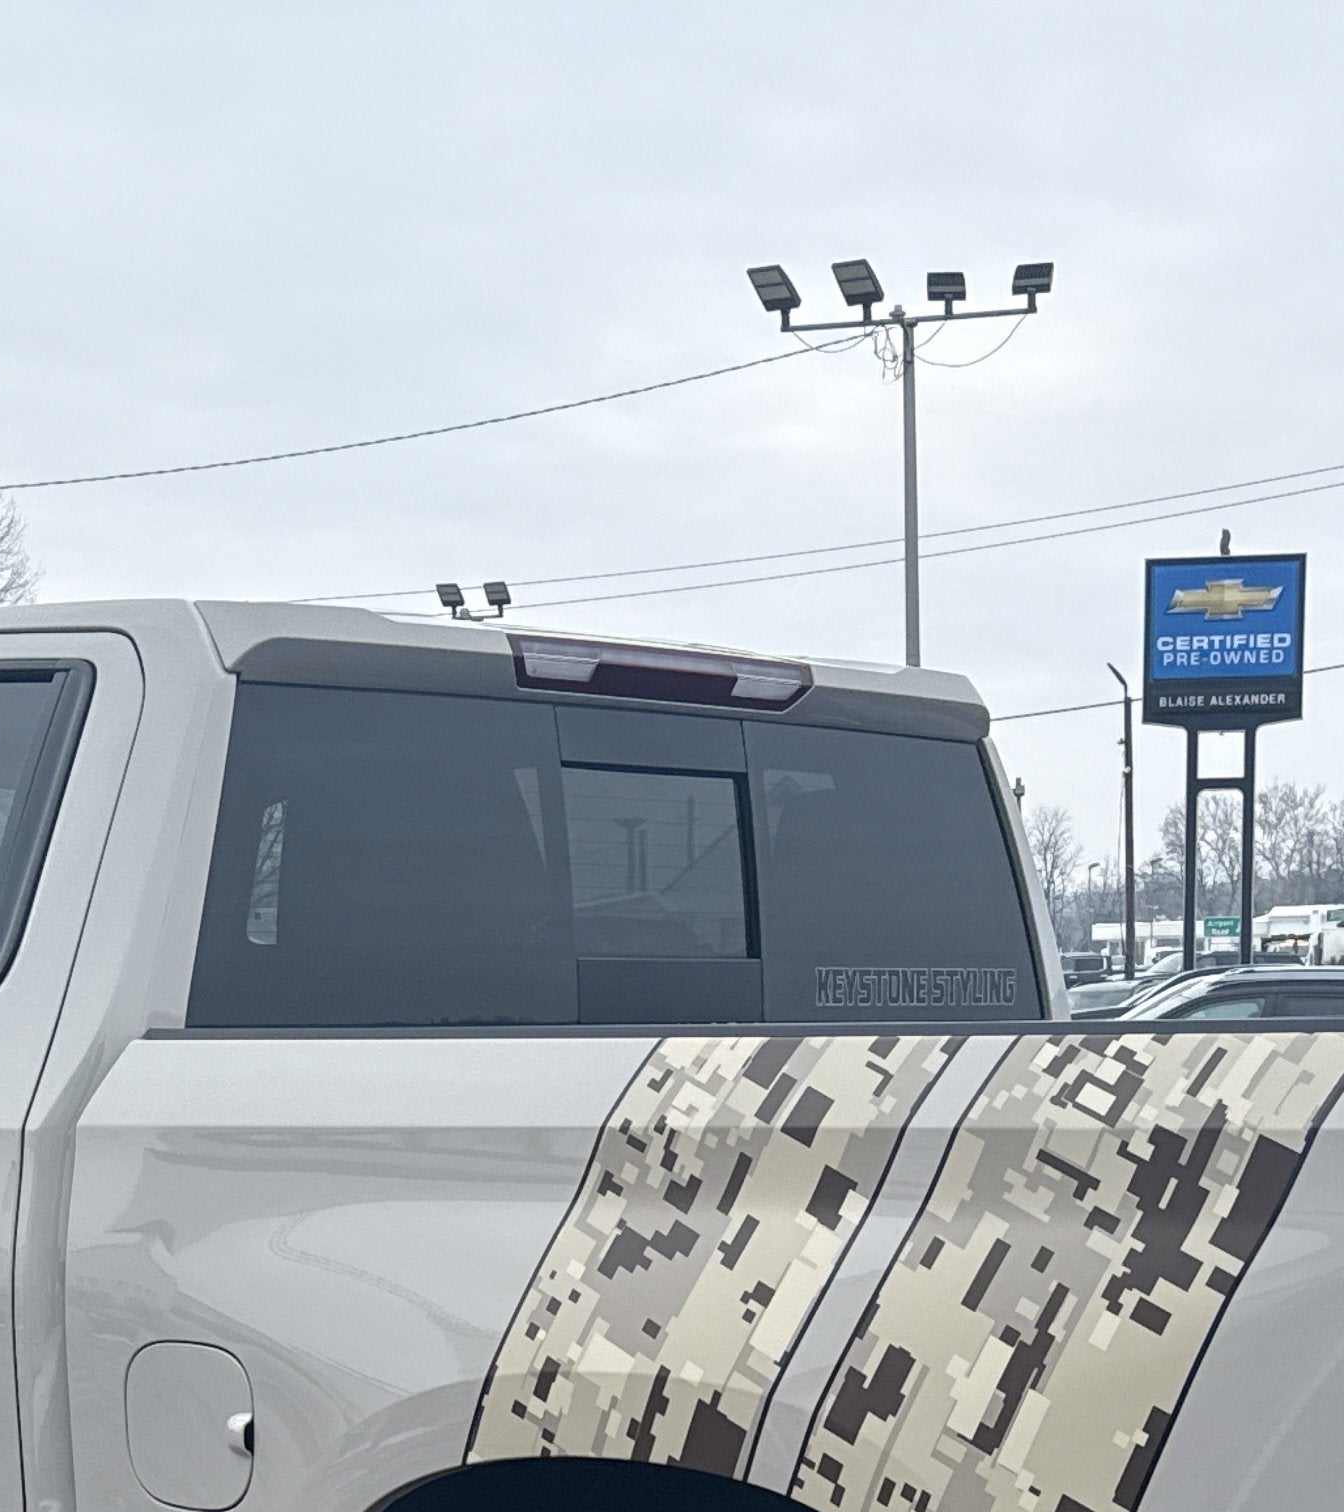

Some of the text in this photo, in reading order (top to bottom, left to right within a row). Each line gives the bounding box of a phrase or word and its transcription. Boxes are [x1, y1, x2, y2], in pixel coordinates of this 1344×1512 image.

[1157, 633, 1291, 651] CERTIFIED
[1163, 650, 1284, 666] PRE-OWNED
[1159, 693, 1286, 707] BLAISE ALEXANDER
[815, 967, 1017, 1006] KEYSTONE STYLING
